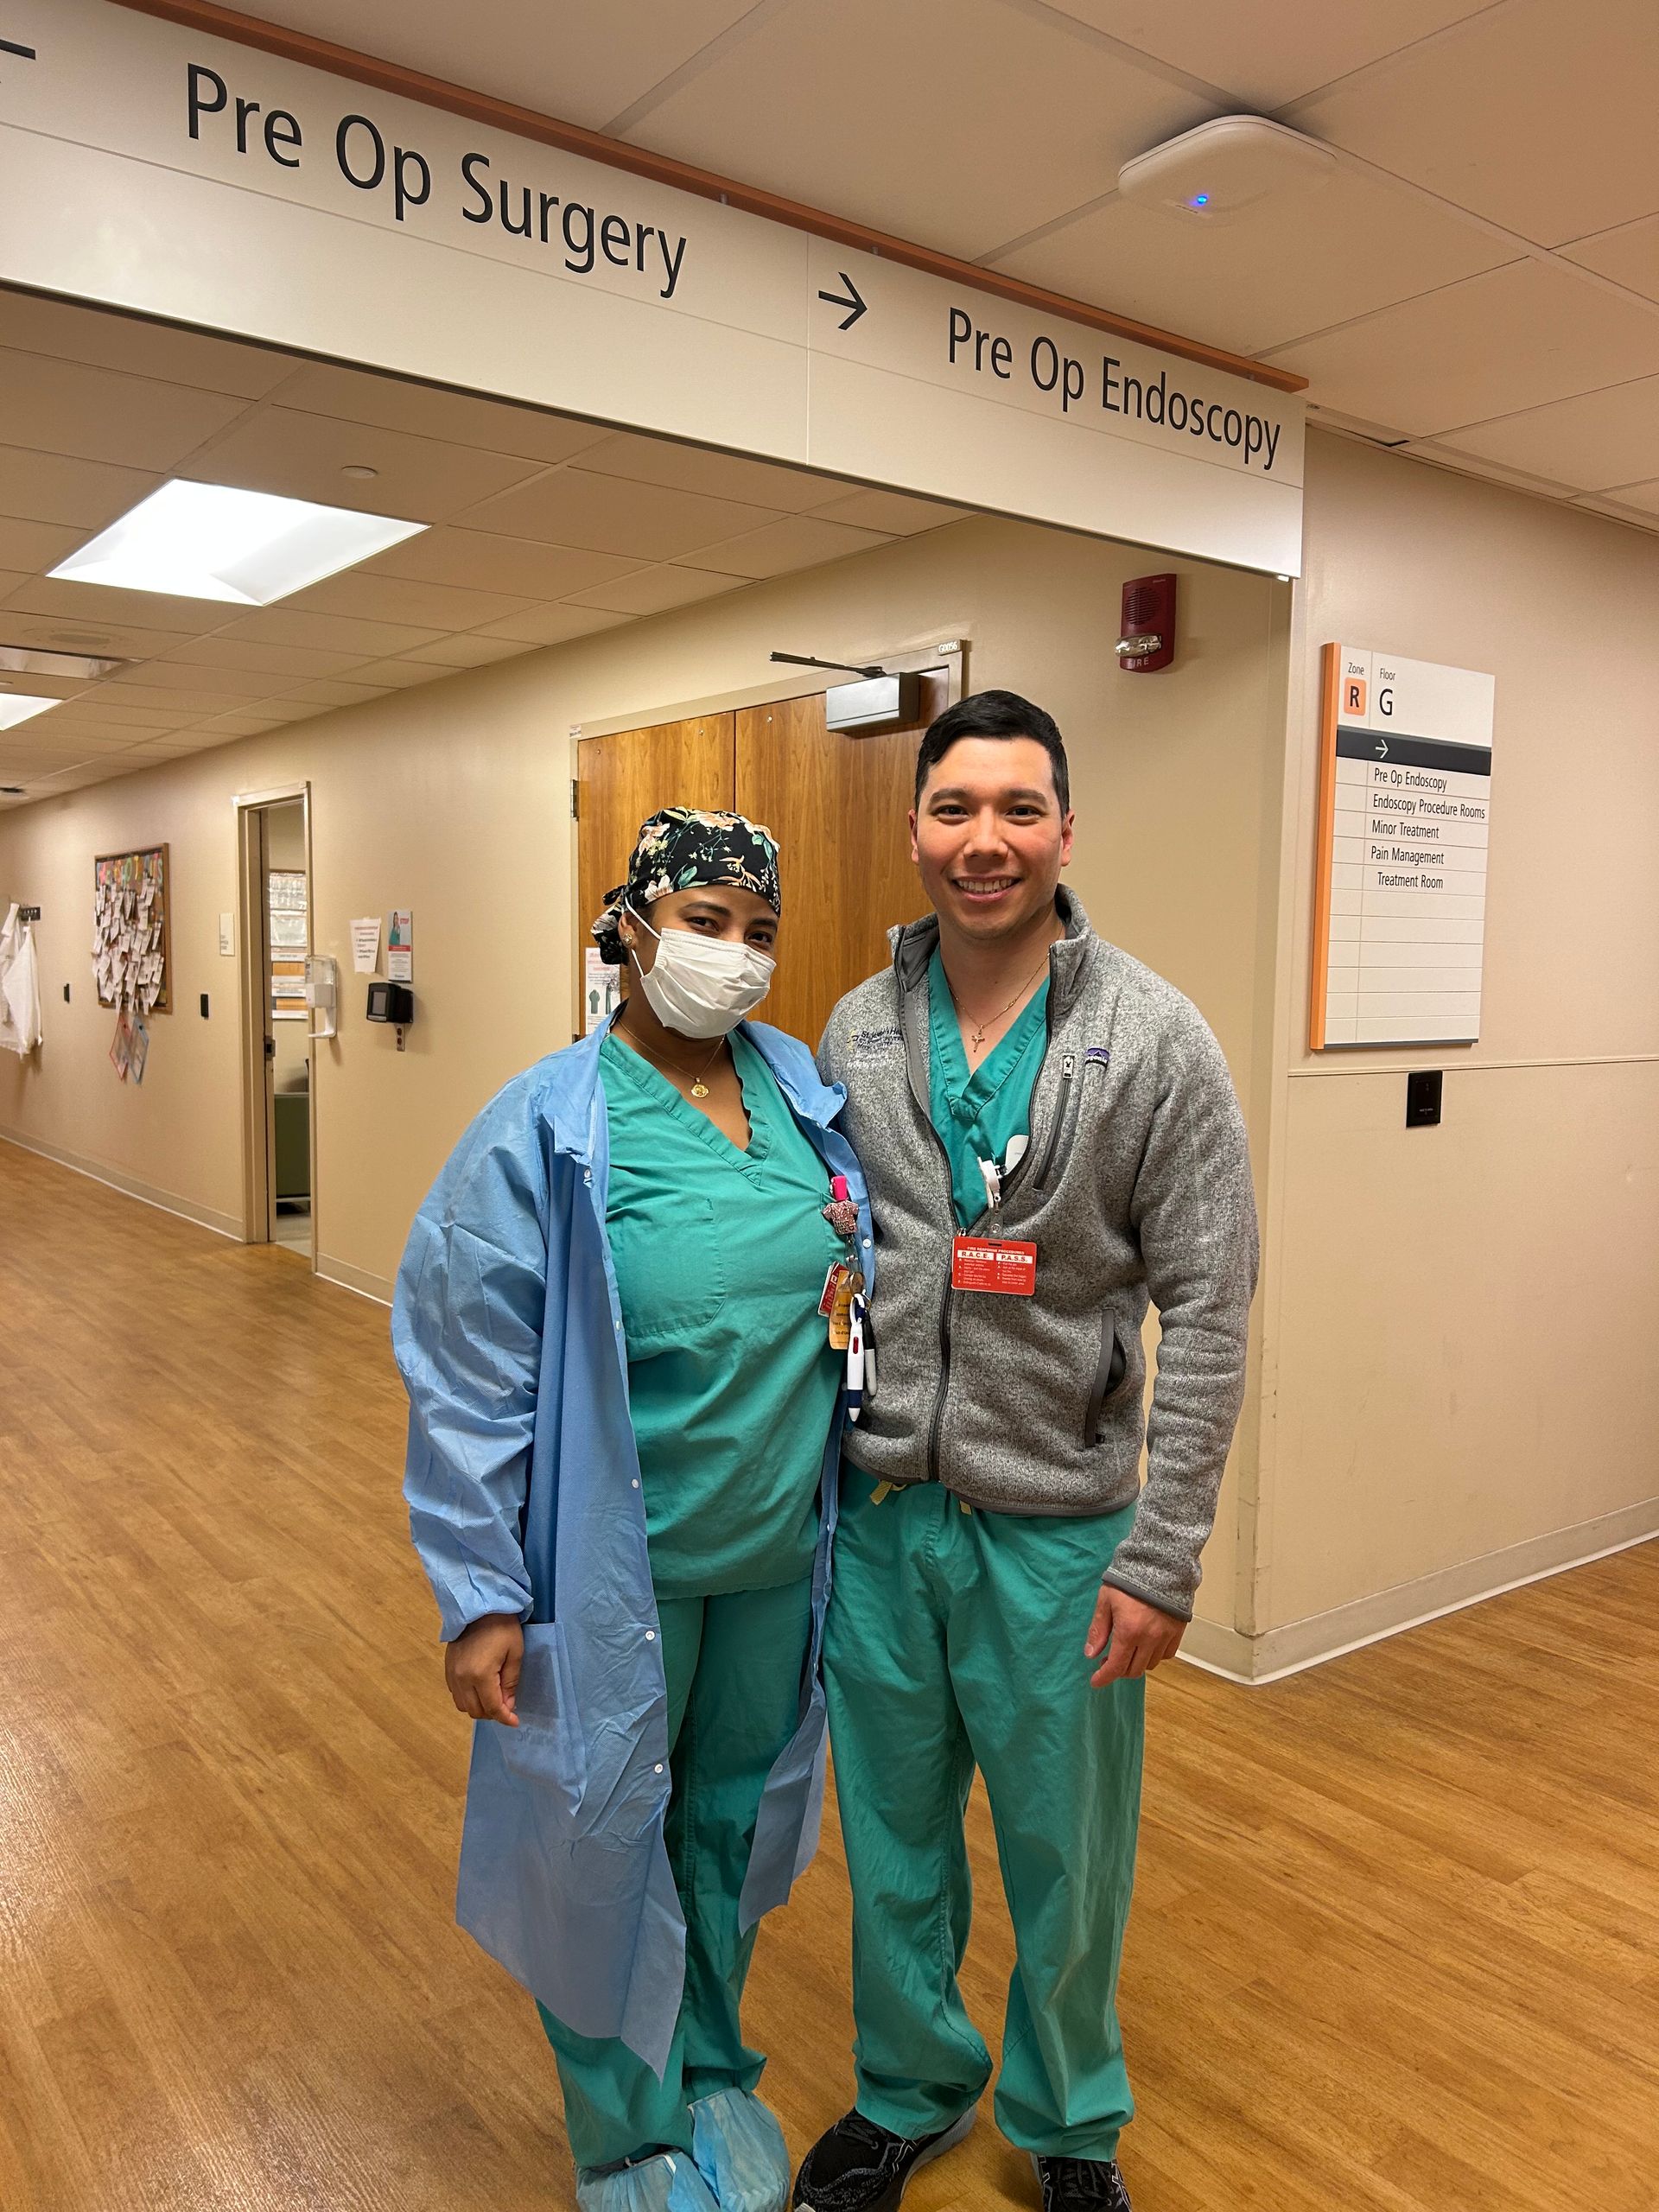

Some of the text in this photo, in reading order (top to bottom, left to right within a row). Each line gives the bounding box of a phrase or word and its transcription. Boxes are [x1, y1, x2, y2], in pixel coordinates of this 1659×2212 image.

[187, 62, 688, 299] Pre Op Surgery
[949, 307, 1281, 471] Pre Op Endoscopy
[1348, 662, 1364, 675] Zone
[1379, 667, 1395, 681] Floor
[1350, 685, 1359, 708] R
[1379, 688, 1393, 716] G
[1374, 767, 1447, 793] Pre Op Endoscopy
[1373, 793, 1485, 819] Endoscopy Procedure Rooms
[1371, 819, 1440, 839] Minor Treatment
[1370, 845, 1444, 866] Pain Management
[1377, 872, 1444, 889] Treatment Room
